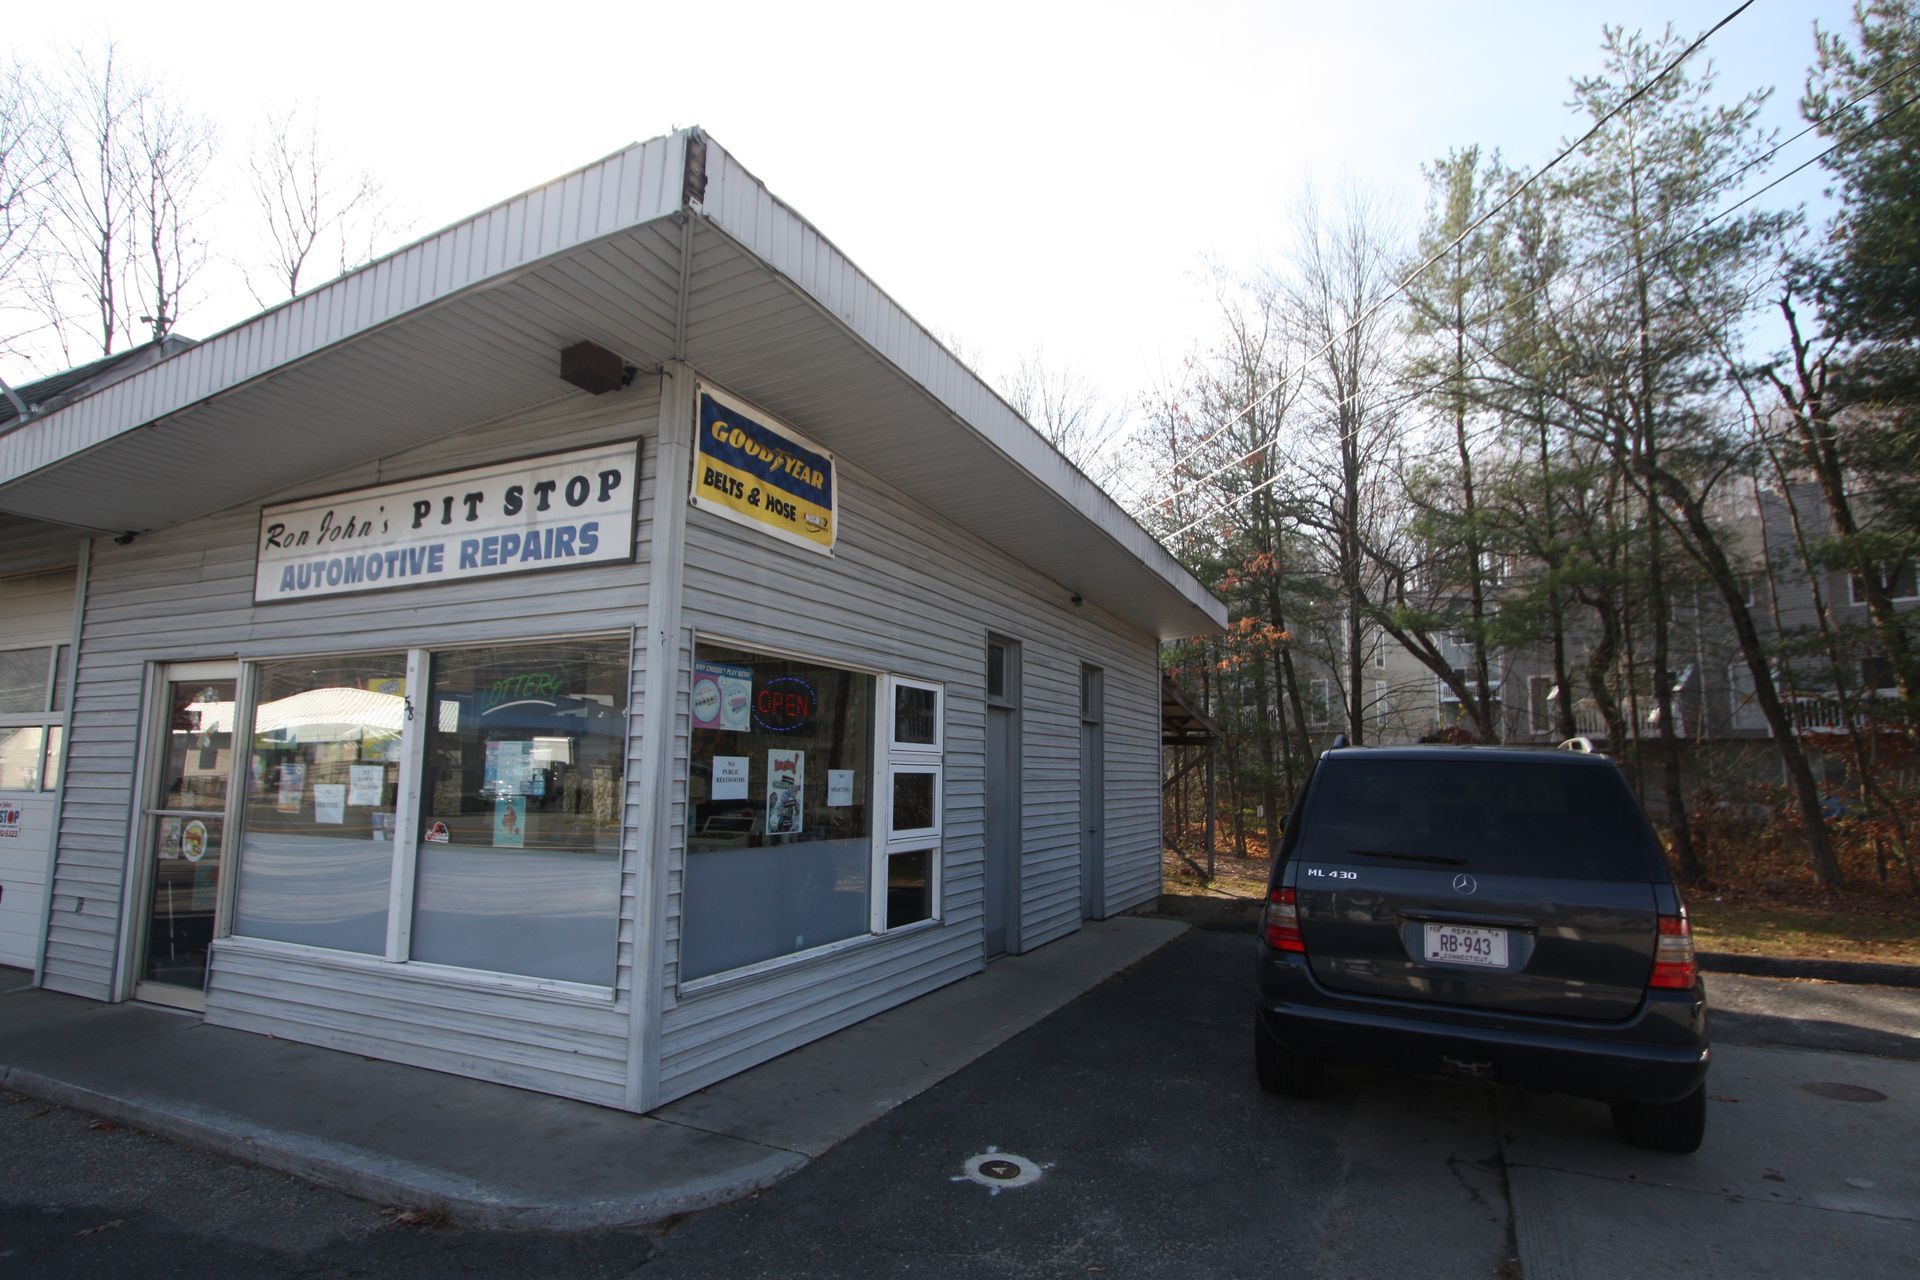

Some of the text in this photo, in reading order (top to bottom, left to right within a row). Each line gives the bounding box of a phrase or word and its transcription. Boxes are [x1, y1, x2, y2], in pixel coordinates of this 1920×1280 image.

[711, 420, 824, 490] GOODYEAR
[265, 469, 622, 551] Ron John's PIT STOP
[703, 466, 797, 522] BELTS & HOSE
[279, 521, 600, 593] AUTOMOTIVE REPAIRS
[480, 672, 561, 711] LOTTERY
[757, 689, 809, 718] OPEN
[722, 768, 740, 776] PUBLIC
[1308, 868, 1357, 880] ML 430
[1451, 928, 1479, 936] REPAIR
[1443, 954, 1488, 962] CONNECTICUT
